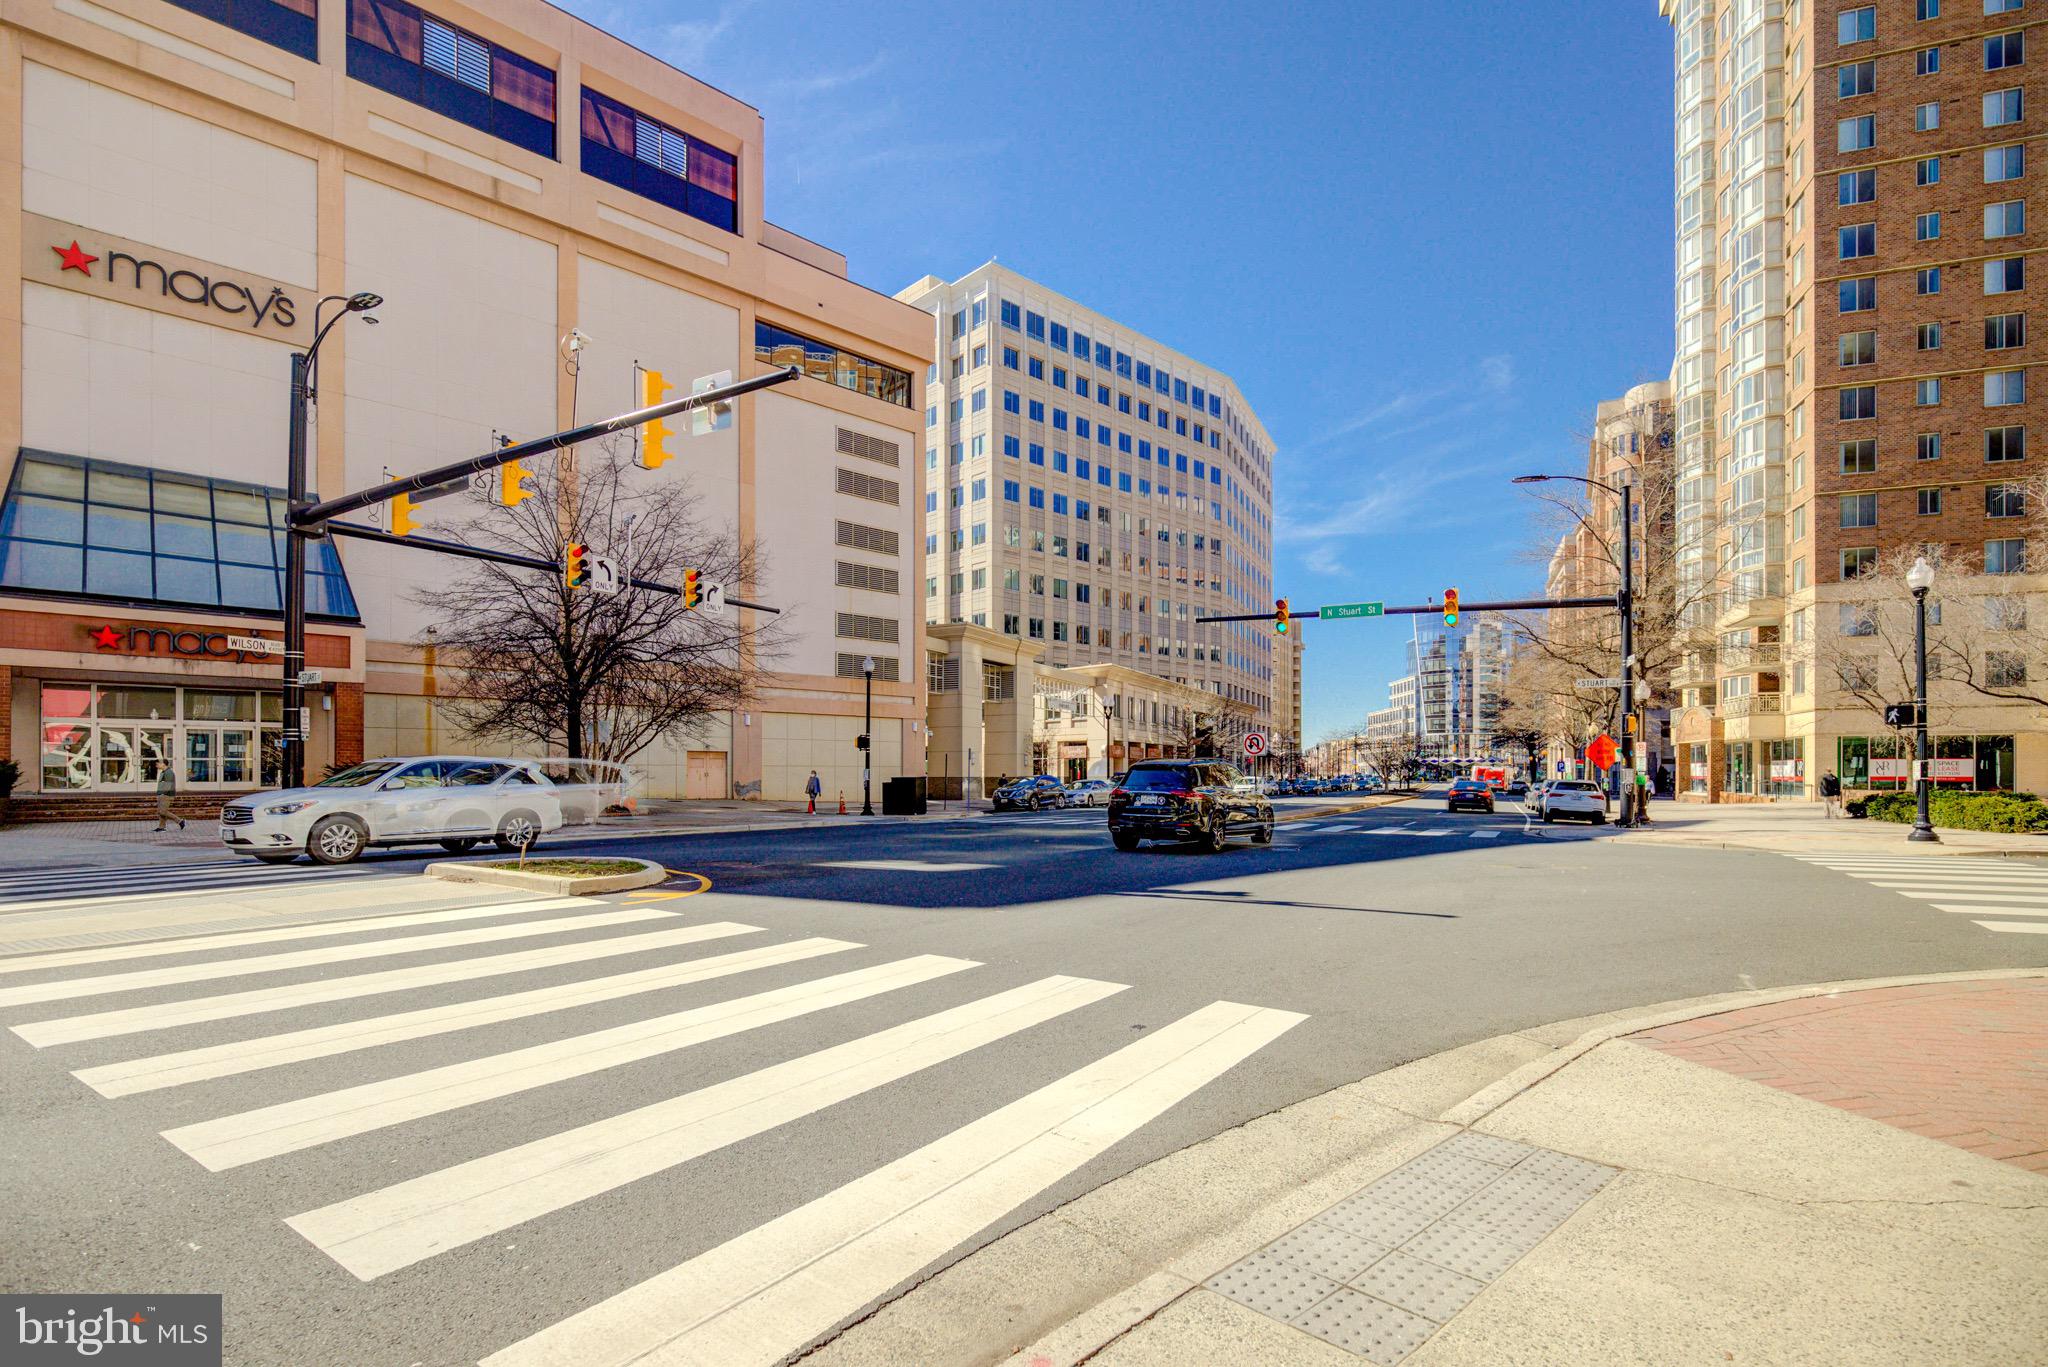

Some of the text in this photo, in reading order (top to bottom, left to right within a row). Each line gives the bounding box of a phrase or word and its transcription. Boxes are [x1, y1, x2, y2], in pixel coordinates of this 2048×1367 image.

[108, 250, 296, 328] macy's
[595, 582, 614, 591] ONLY
[706, 603, 722, 612] ONLY
[1338, 607, 1361, 616] Stuart
[1368, 606, 1376, 614] St
[230, 637, 266, 650] WILSON
[301, 672, 317, 682] STUART
[1581, 679, 1608, 687] STUART
